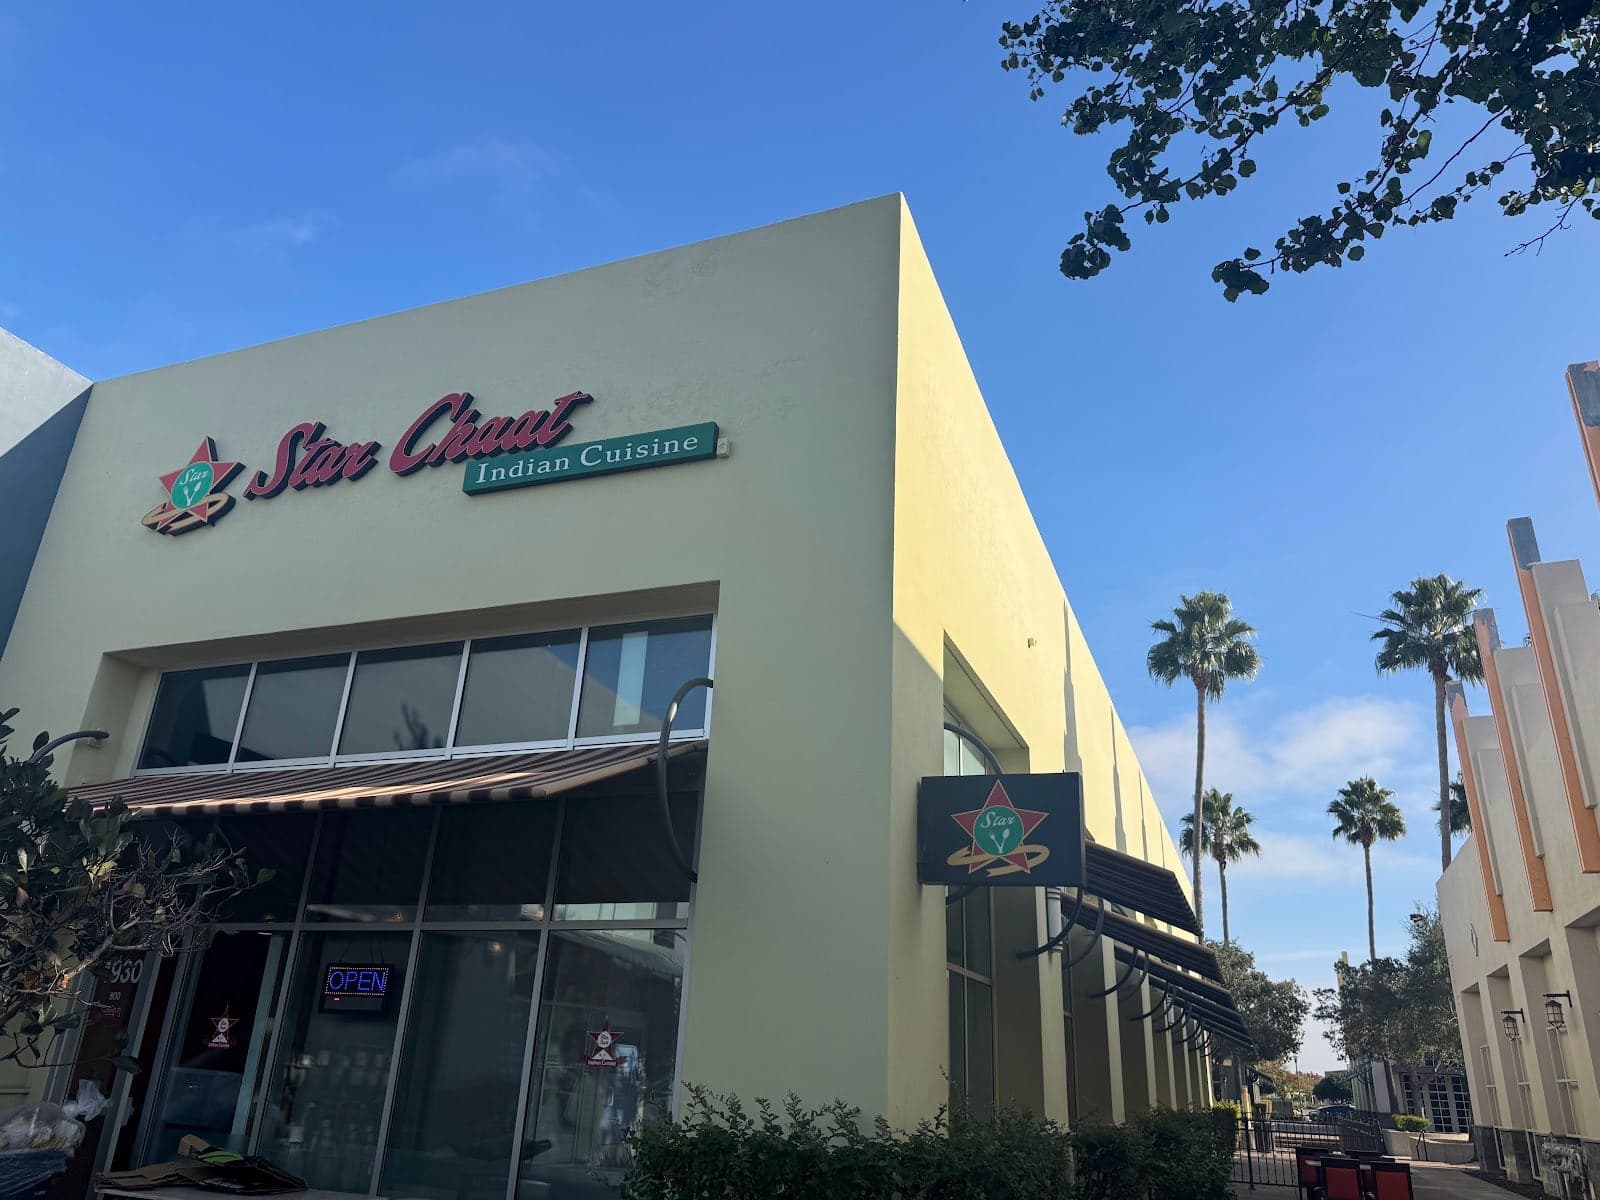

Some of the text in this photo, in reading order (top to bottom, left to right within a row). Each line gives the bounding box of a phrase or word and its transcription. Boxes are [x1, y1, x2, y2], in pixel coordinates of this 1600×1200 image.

[244, 391, 594, 500] Star Chaat
[475, 436, 699, 484] Indian Cuisine
[178, 467, 208, 486] Star
[980, 811, 1017, 829] Star
[329, 971, 386, 991] OPEN
